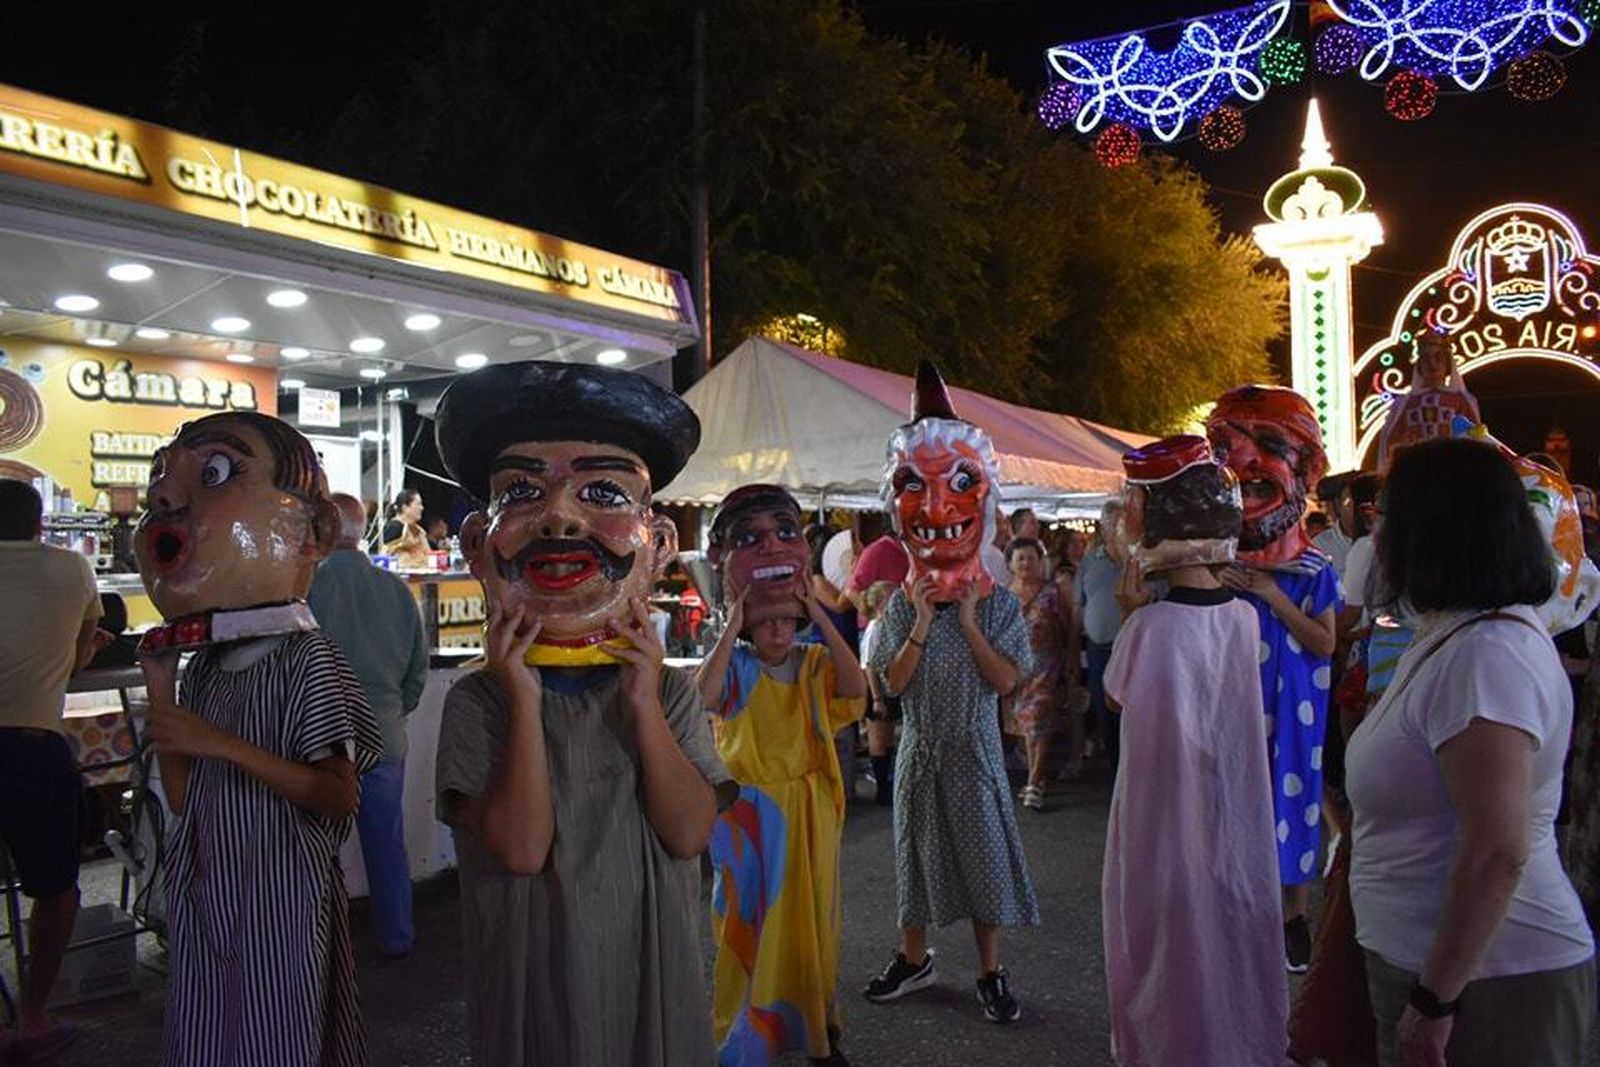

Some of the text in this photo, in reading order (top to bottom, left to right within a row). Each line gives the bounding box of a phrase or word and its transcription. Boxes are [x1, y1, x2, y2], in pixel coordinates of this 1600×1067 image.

[0, 112, 150, 183] RERÍA
[167, 158, 438, 251] CHOCOLATERÍA
[448, 228, 589, 287] HERMANOS
[68, 359, 258, 409] Cámara
